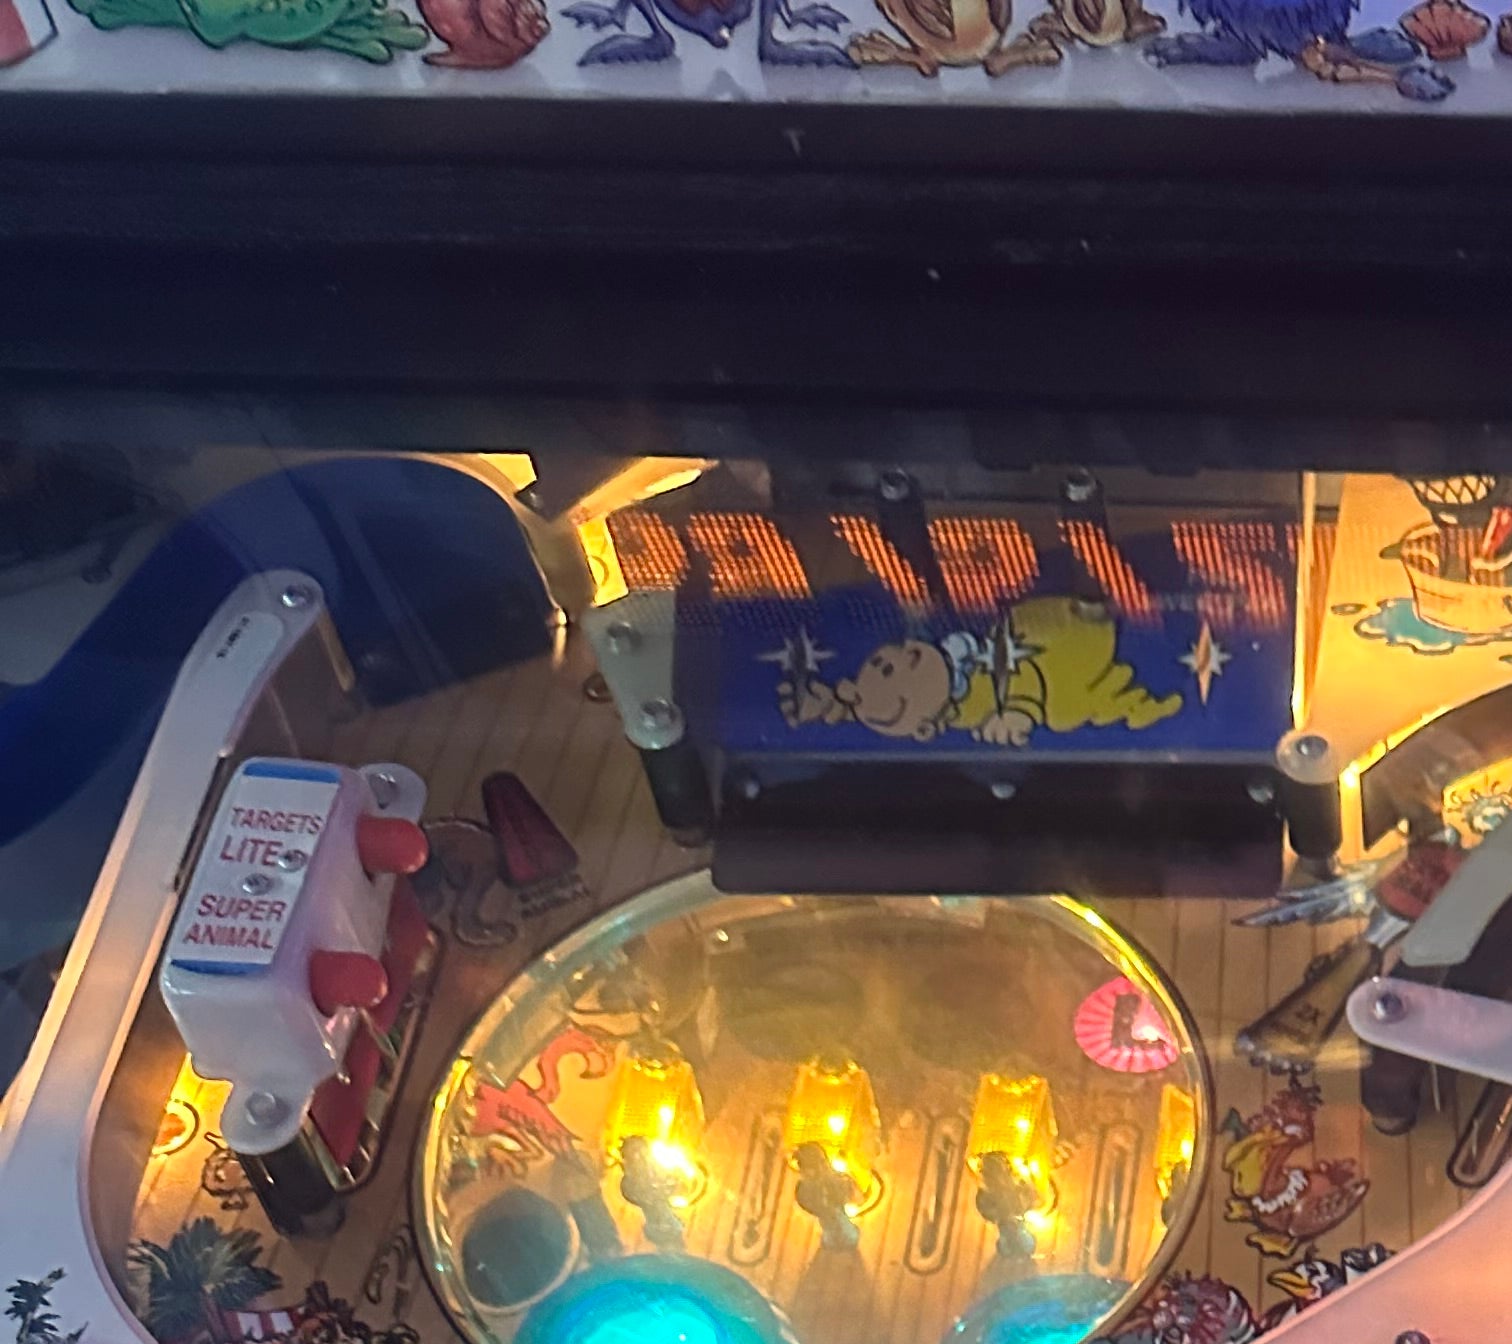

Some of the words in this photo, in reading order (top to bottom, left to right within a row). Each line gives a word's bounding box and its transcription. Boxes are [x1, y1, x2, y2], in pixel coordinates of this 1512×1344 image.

[231, 807, 325, 835] TARGETS
[220, 835, 284, 867] LITE
[197, 894, 288, 922] SUPER
[183, 924, 275, 949] ANIMAL
